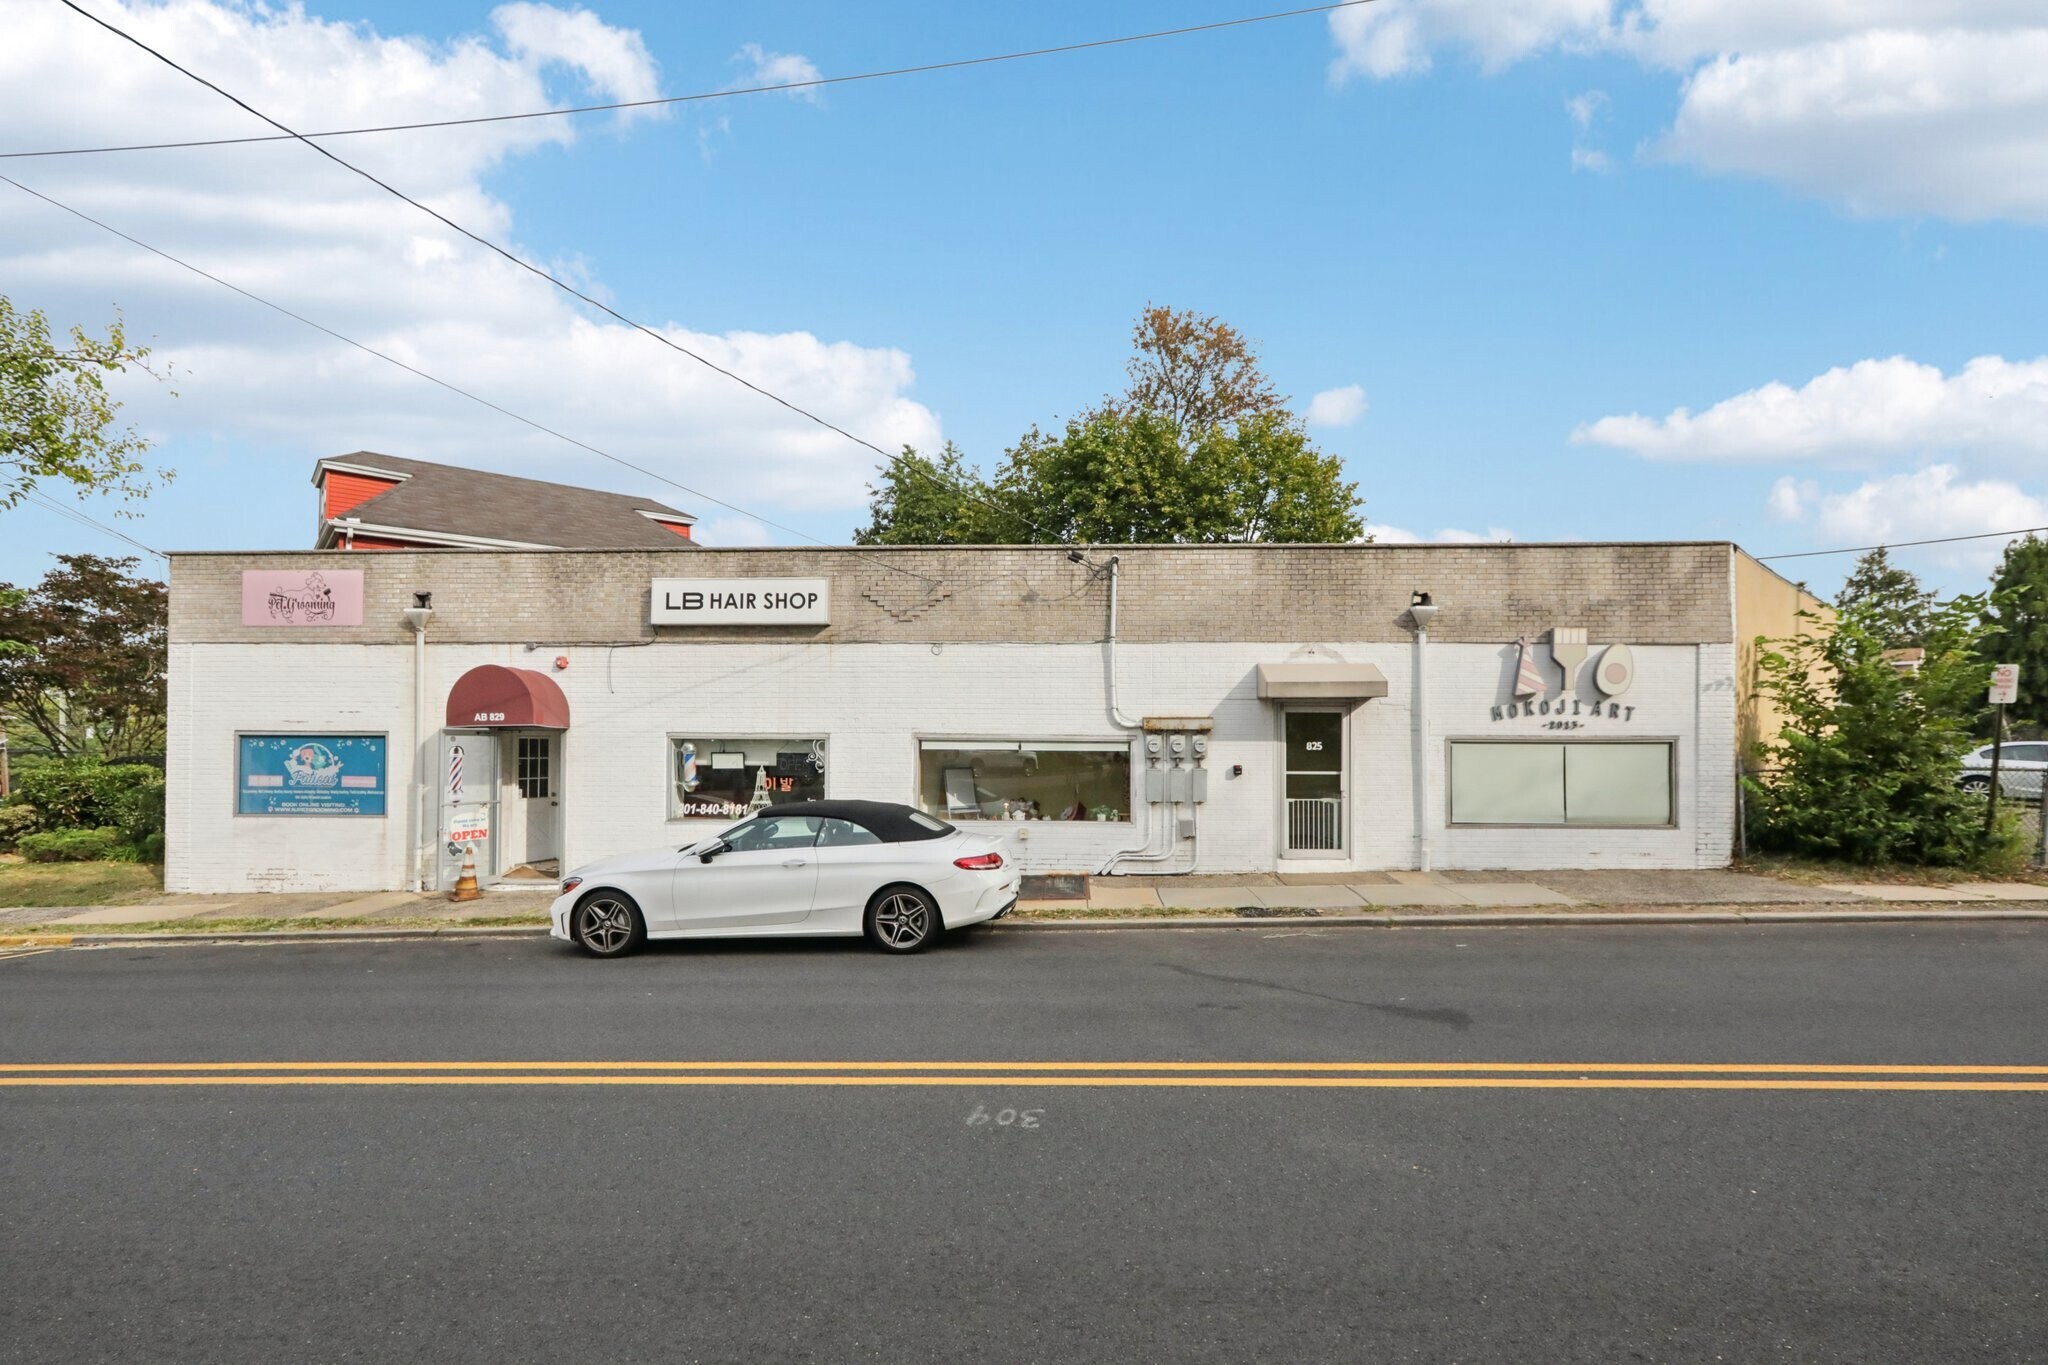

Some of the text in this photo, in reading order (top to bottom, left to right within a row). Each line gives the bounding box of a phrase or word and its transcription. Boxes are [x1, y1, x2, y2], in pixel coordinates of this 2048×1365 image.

[665, 592, 818, 610] LB HAIR SHOP
[474, 712, 505, 721] AB 829
[1490, 699, 1635, 722] MOKOJI ART
[1306, 741, 1323, 751] 825
[451, 829, 488, 842] OPEN
